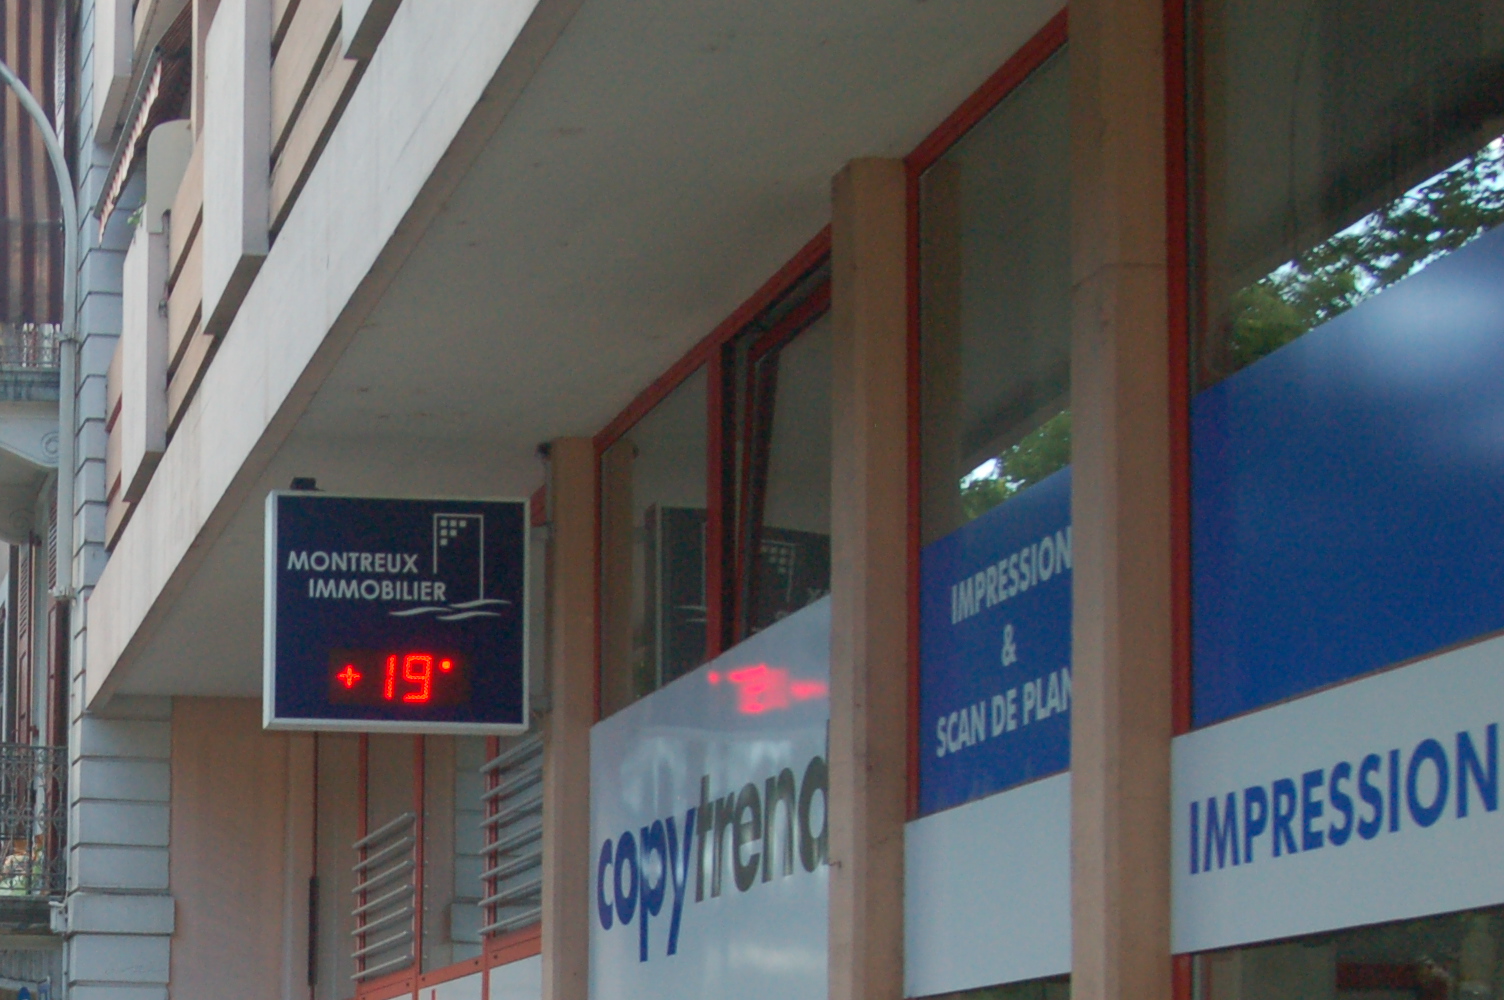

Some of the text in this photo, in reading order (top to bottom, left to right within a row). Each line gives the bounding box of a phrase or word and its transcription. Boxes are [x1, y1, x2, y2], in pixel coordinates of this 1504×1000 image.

[287, 550, 418, 574] MONTREUX
[309, 578, 447, 601] IMMOBILIER
[951, 525, 1073, 625] IMPRESSION
[1001, 623, 1017, 667] &
[936, 700, 986, 758] SCAN
[991, 688, 1017, 738] DE
[1189, 722, 1499, 876] IMPRESSION
[597, 719, 830, 963] copytrend
